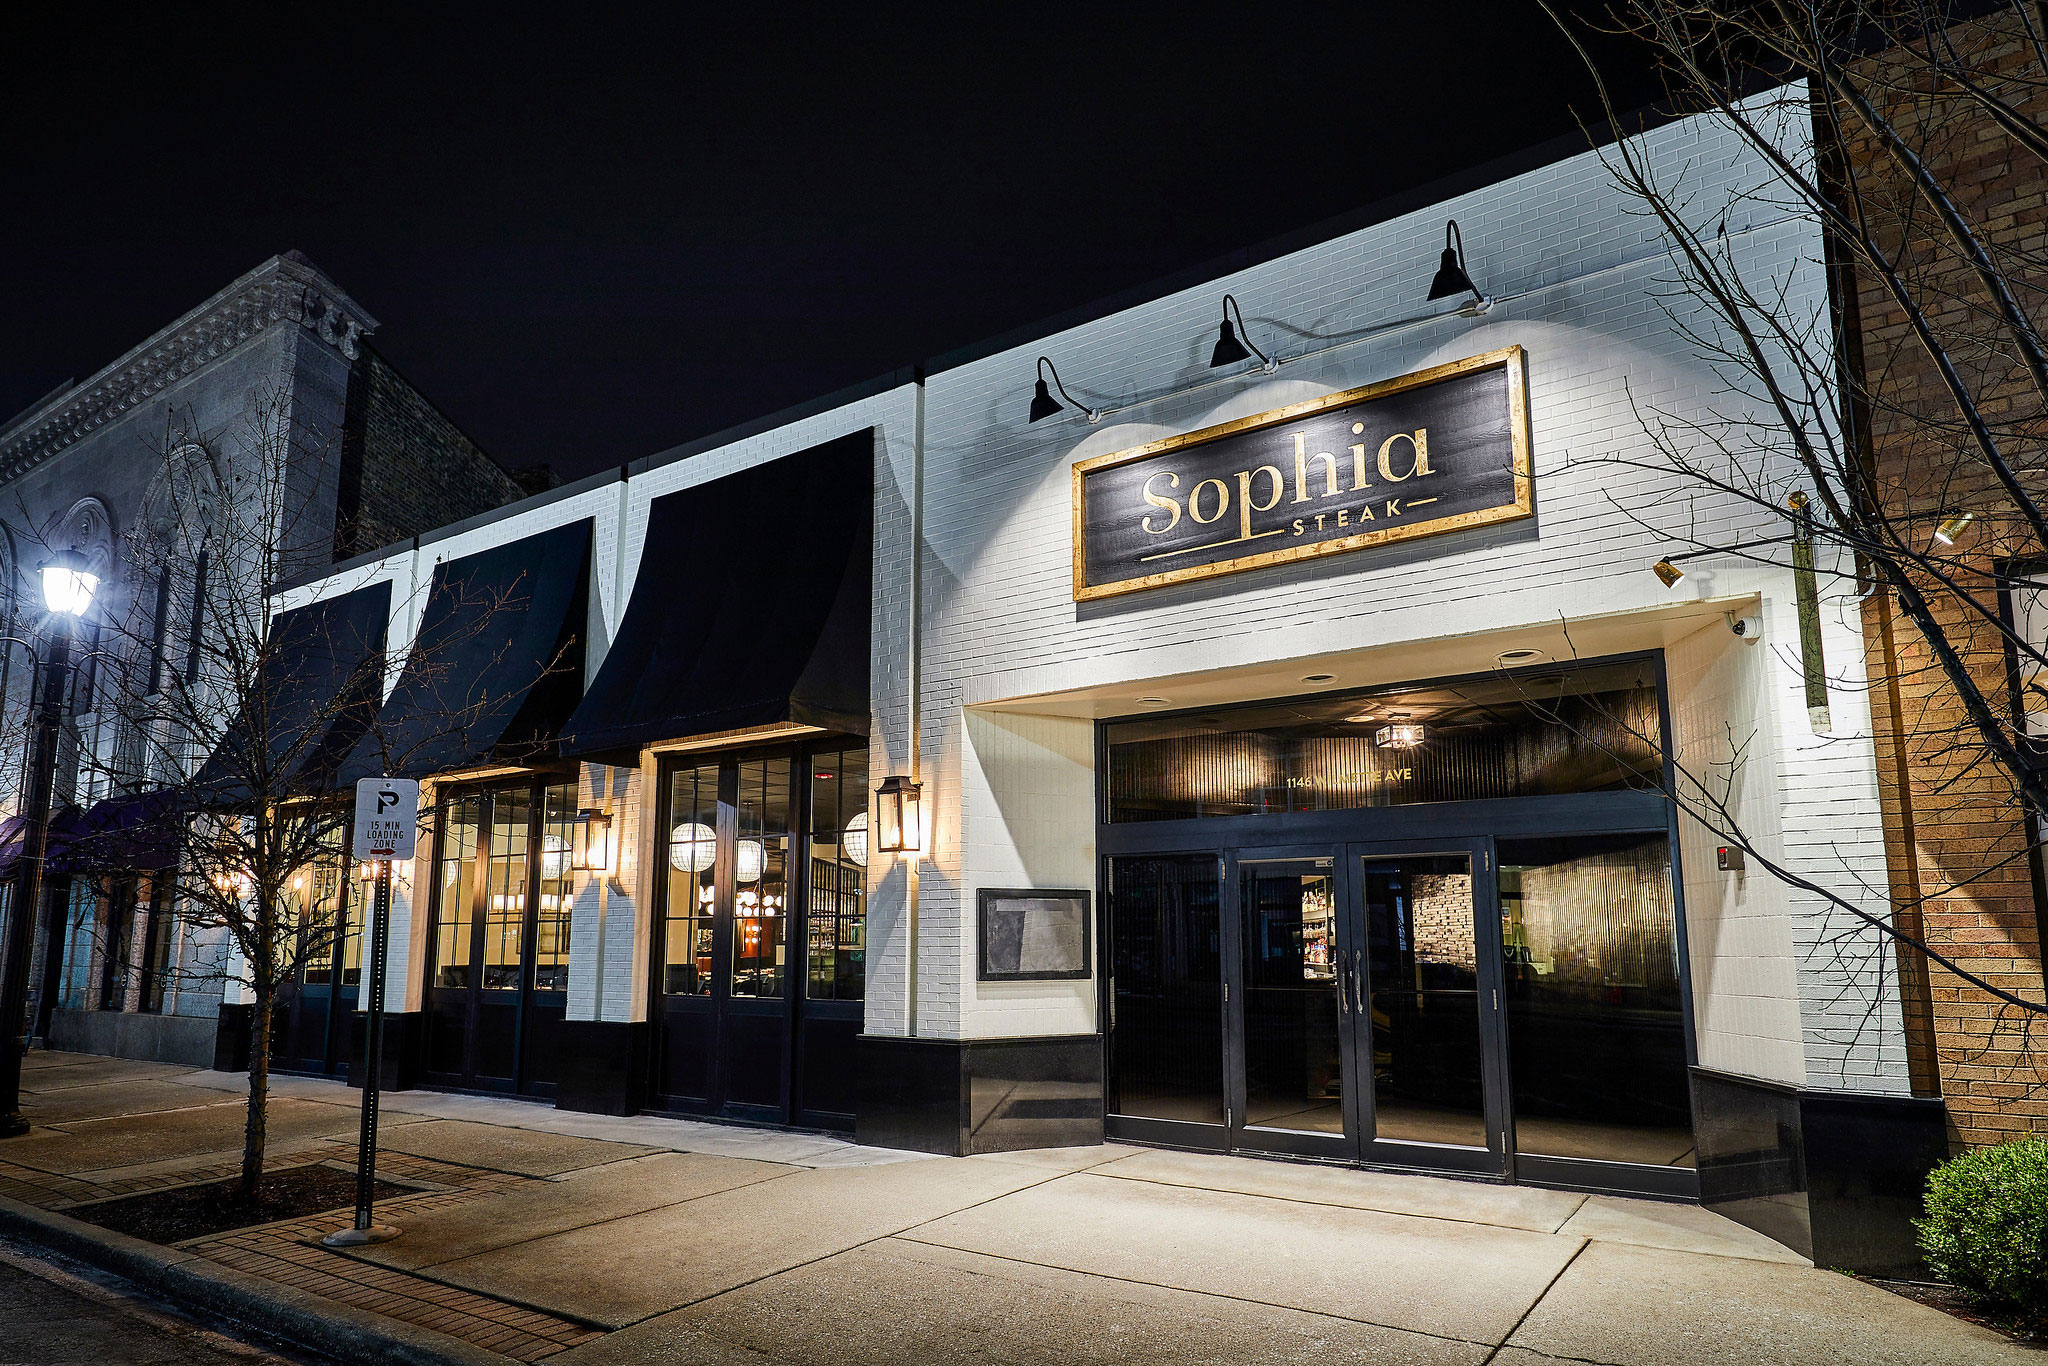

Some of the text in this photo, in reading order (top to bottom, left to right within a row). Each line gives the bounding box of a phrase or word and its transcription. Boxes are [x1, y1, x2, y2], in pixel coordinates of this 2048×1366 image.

[1141, 422, 1436, 540] Sophia
[1293, 498, 1402, 536] STEAK
[1286, 776, 1312, 789] 1146
[1384, 768, 1412, 781] AVE
[377, 791, 399, 814] P
[367, 830, 404, 839] LOADING
[371, 821, 400, 830] 15 MIN
[374, 839, 395, 848] ZONE
